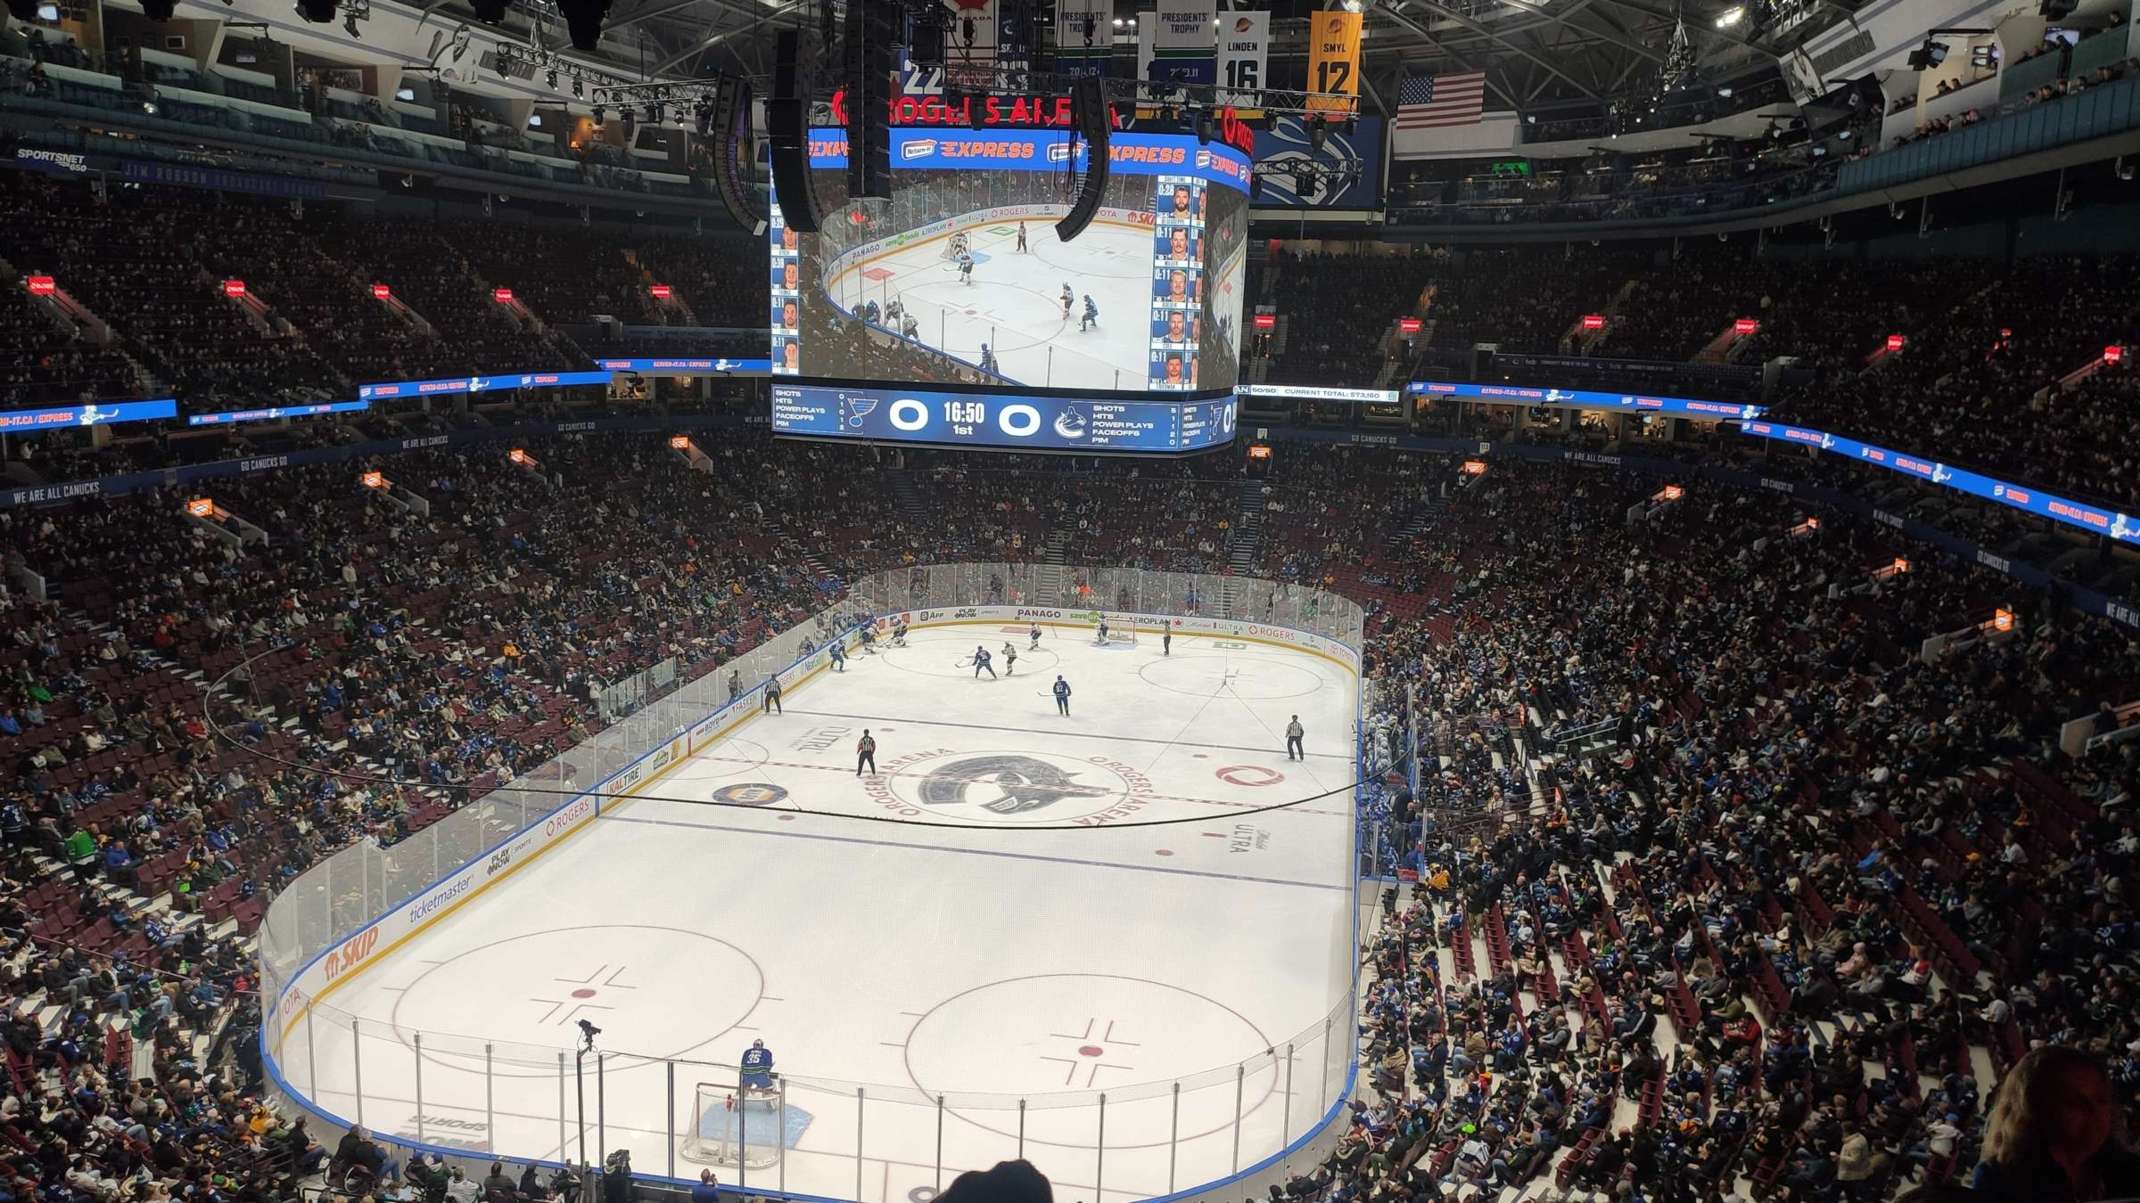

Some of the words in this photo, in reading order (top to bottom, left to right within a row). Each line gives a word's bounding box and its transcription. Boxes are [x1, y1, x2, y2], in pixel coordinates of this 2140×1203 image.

[1162, 13, 1209, 23] PRESIDENTS'
[1069, 22, 1097, 33] TROY
[1170, 24, 1201, 34] TROPHY
[1227, 42, 1258, 52] LINDEN
[1323, 43, 1346, 53] SMYL
[903, 59, 944, 94] 22
[1225, 59, 1258, 96] 16
[1317, 61, 1350, 95] 12
[18, 149, 85, 165] SPORTSNET
[940, 141, 1035, 159] EXPRESS
[1109, 145, 1186, 164] XPRESS
[69, 163, 88, 173] 650
[775, 390, 801, 398] SHOTS
[838, 393, 845, 401] 0
[1285, 388, 1321, 396] CURRENT
[1323, 390, 1349, 398] TOTAL:
[775, 397, 793, 405] HITS
[775, 405, 801, 413] POWER
[801, 407, 826, 415] PLAYS
[889, 399, 929, 431] 0
[943, 401, 985, 424] 16:50
[1093, 405, 1126, 413] SHOTS
[1093, 412, 1114, 420] HITS
[39, 412, 74, 424] EXPRESS
[775, 412, 815, 421] FACEOFFS
[999, 404, 1041, 437] 0
[953, 425, 973, 435] 1st
[1092, 420, 1125, 429] POWER
[1125, 422, 1154, 430] PLAYS
[1092, 429, 1141, 437] FACEOFFS
[1092, 436, 1109, 444] PIM
[241, 461, 250, 472] GO
[251, 457, 279, 470] CANUCKS
[279, 455, 288, 466] GO
[13, 490, 28, 503] WE
[29, 488, 45, 501] ARE
[47, 485, 62, 499] ALL
[63, 481, 100, 498] CANUCKS
[1017, 609, 1062, 618] PANAGO
[2106, 602, 2116, 618] WE
[2116, 605, 2129, 623] ARE
[2129, 610, 2140, 628] ALL
[1130, 616, 1171, 626] EROPLAN
[1218, 623, 1243, 632] ULTRA
[1260, 627, 1296, 641] ROGERS
[609, 780, 624, 794] KAL
[623, 767, 640, 790] TIRE
[556, 799, 590, 831] ROGERS
[1229, 824, 1256, 854] ULTRA
[491, 846, 511, 865] PLAY
[492, 854, 511, 871] NOW
[409, 875, 472, 924] ticketmaster
[340, 925, 379, 973] SKIP
[284, 987, 300, 1016] OTA
[407, 1114, 489, 1132] SPORTS
